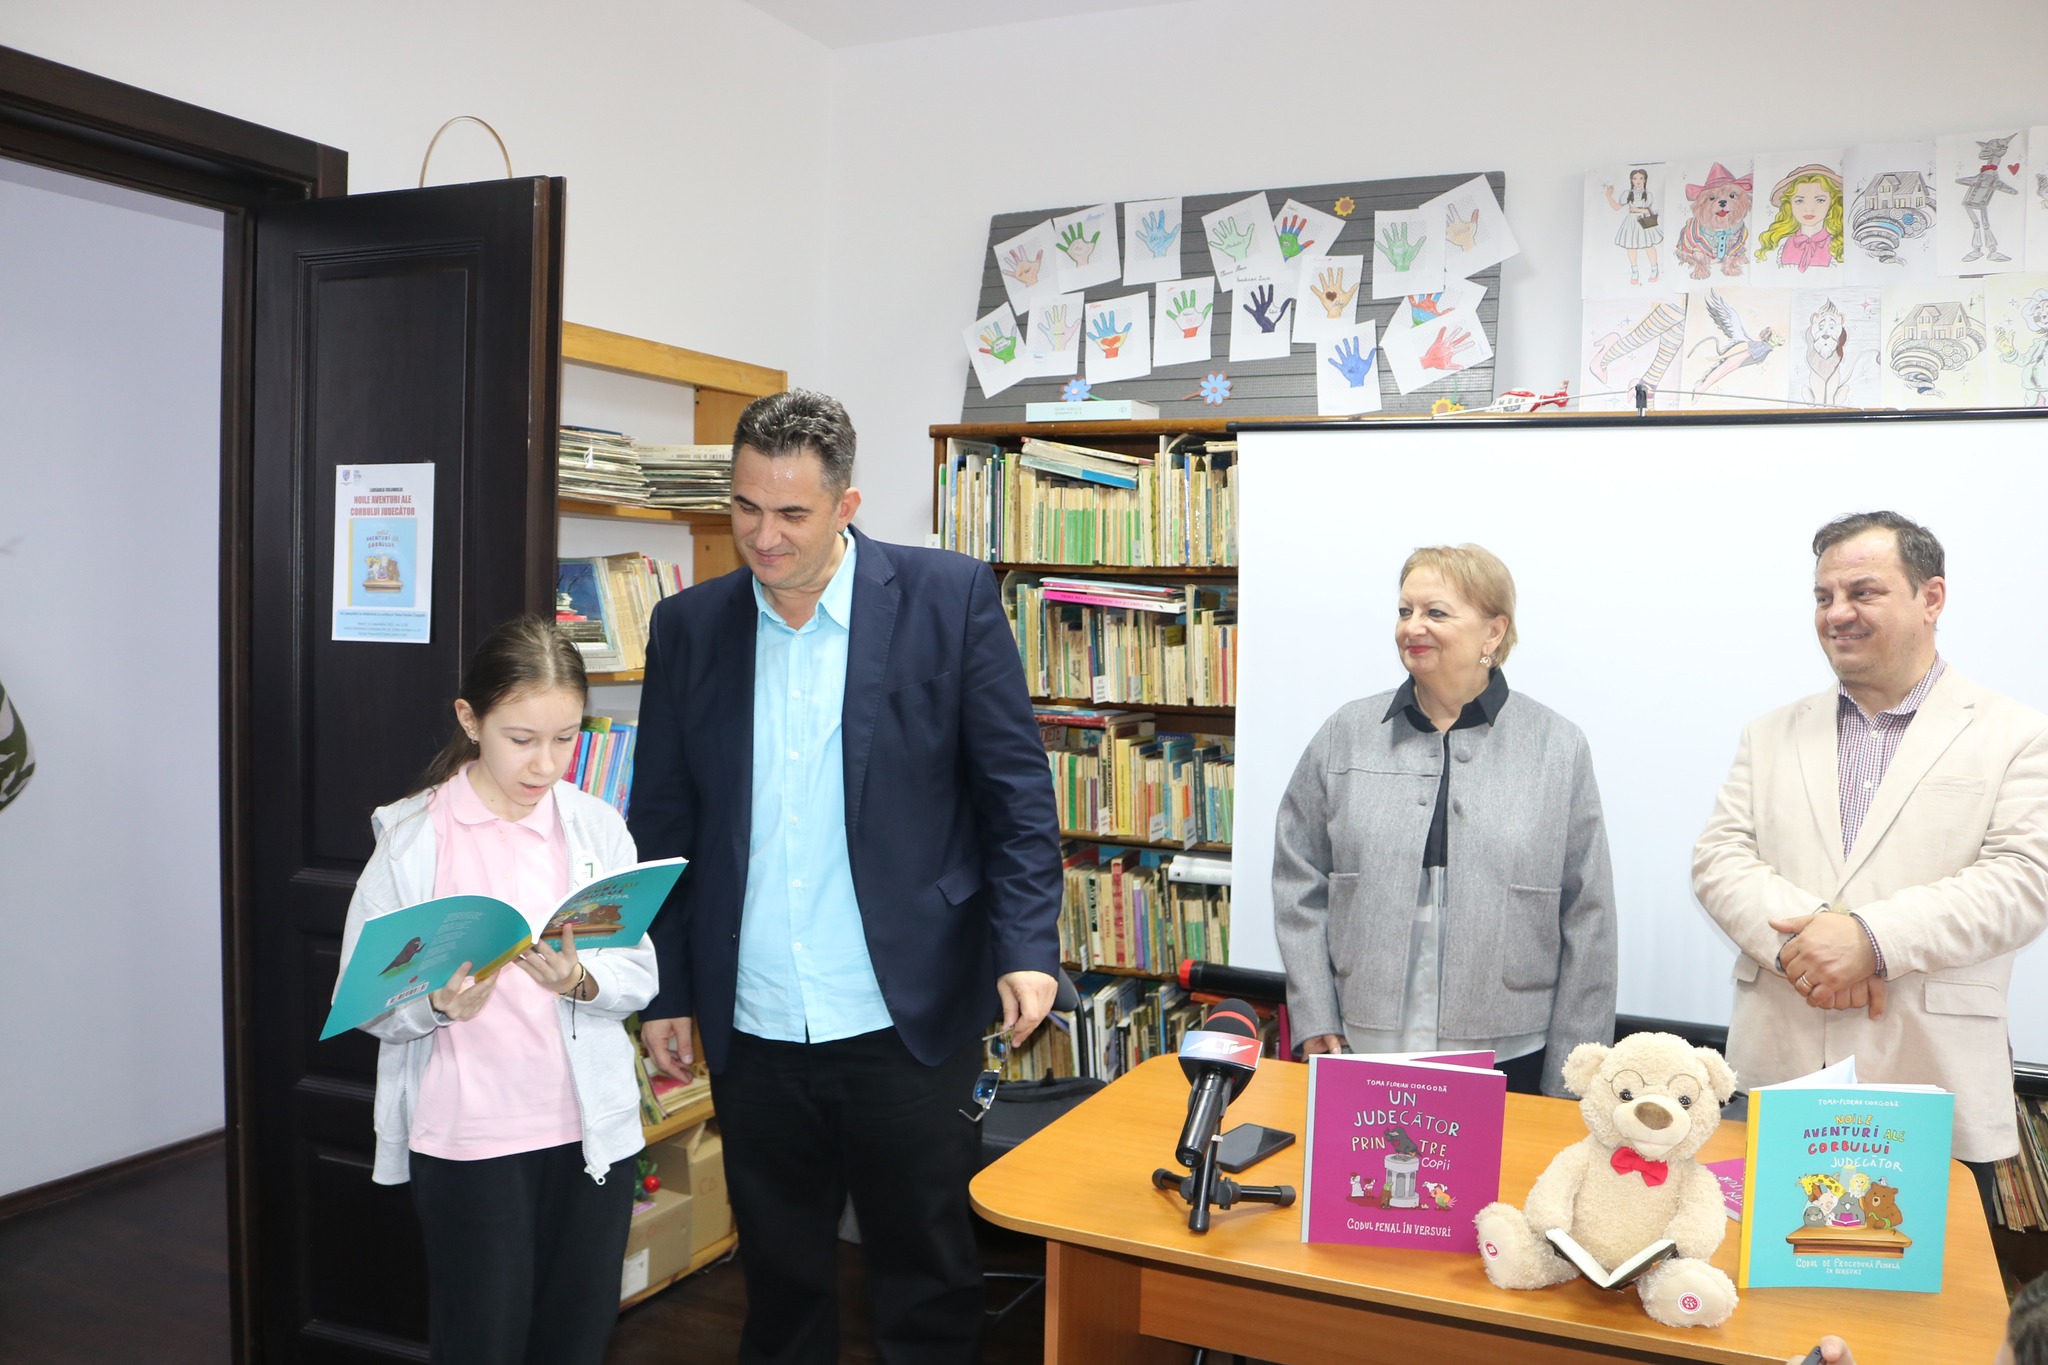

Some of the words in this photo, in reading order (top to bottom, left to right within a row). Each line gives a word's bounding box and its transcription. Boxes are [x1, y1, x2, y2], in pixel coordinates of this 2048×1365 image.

[371, 496, 400, 504] AVENTURI
[401, 495, 412, 503] ALE
[350, 508, 380, 516] CORBULUI
[381, 506, 415, 515] JUDECĂTOR
[1367, 1079, 1385, 1087] TOMA
[1386, 1081, 1409, 1089] FLORIAN
[1389, 1090, 1416, 1106] UN
[1354, 1110, 1460, 1137] JUDECĂTOR
[1835, 1114, 1873, 1125] NOILE
[1804, 1125, 1879, 1139] AVENTURI
[1883, 1129, 1906, 1142] ALE
[1807, 1140, 1890, 1155] CORBULUI
[1830, 1154, 1903, 1172] JUDECĂTOR
[1375, 1222, 1400, 1233] PENAL
[1414, 1224, 1451, 1237] VERSURI
